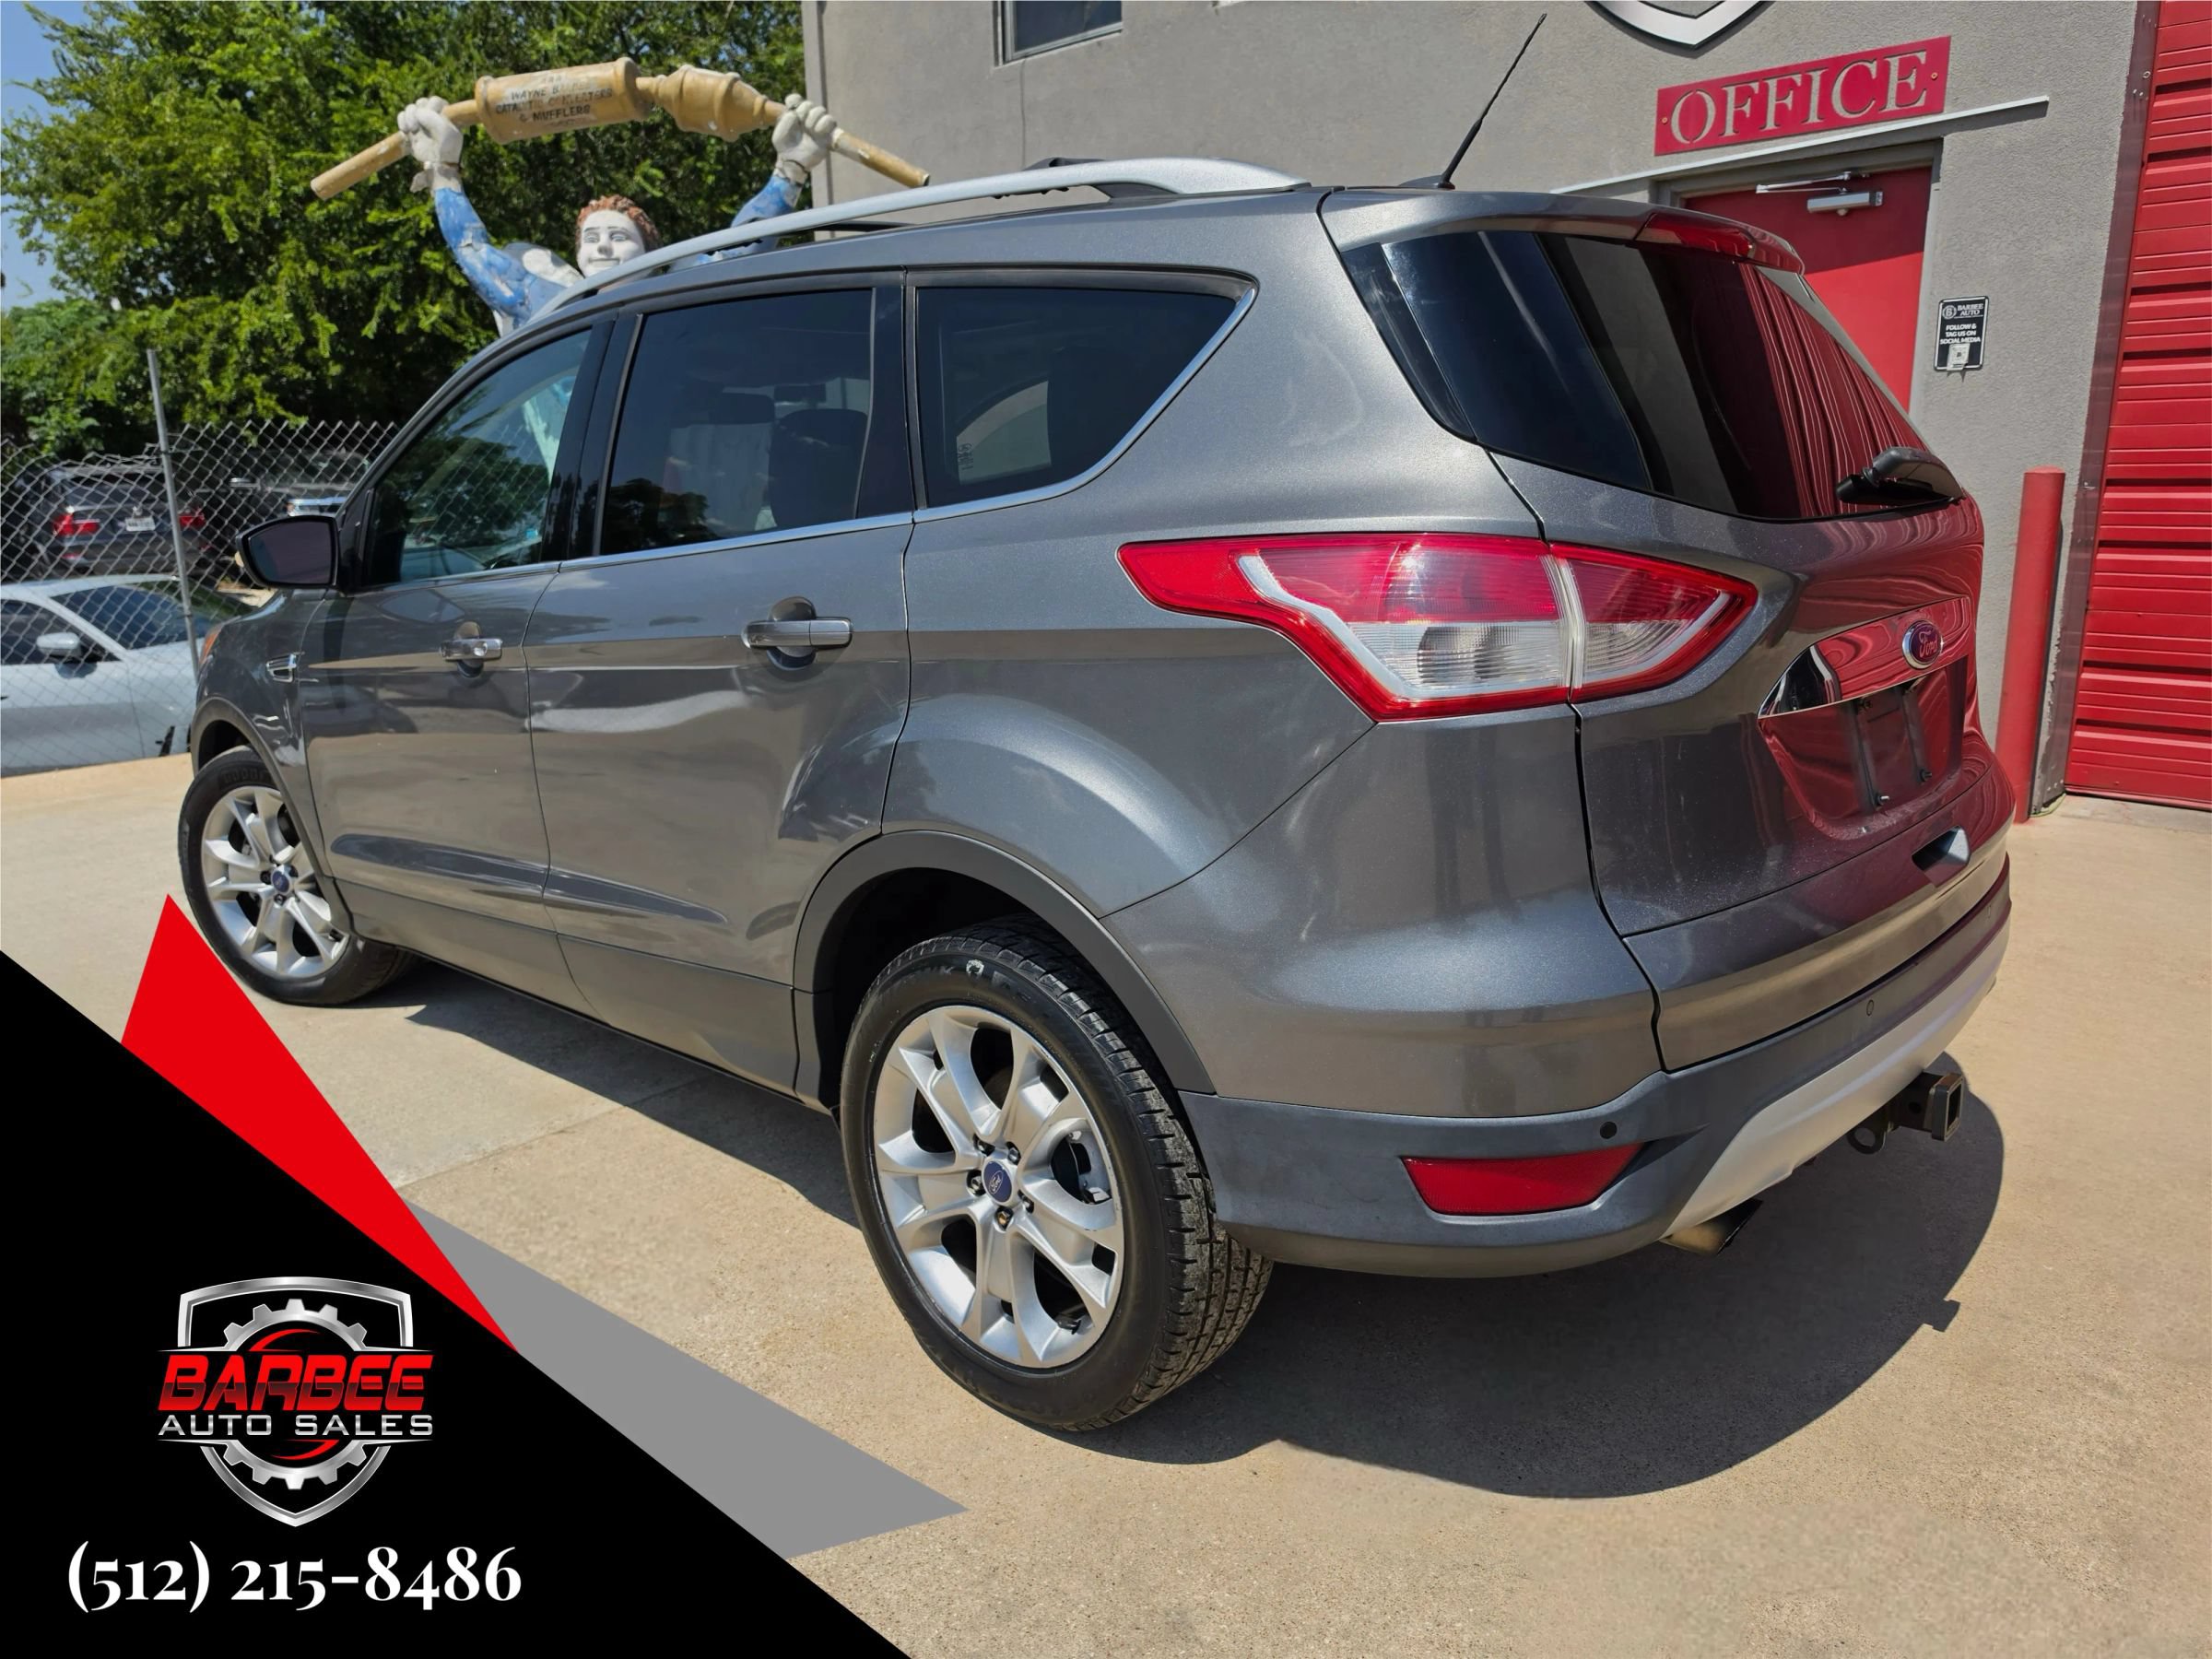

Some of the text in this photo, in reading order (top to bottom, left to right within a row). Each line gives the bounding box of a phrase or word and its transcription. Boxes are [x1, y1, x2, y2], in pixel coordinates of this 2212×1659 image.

[511, 88, 546, 100] WAYNE
[1670, 49, 1927, 145] OFFICE
[532, 104, 591, 122] MUFFLERS
[1957, 303, 1984, 312] BARBEE
